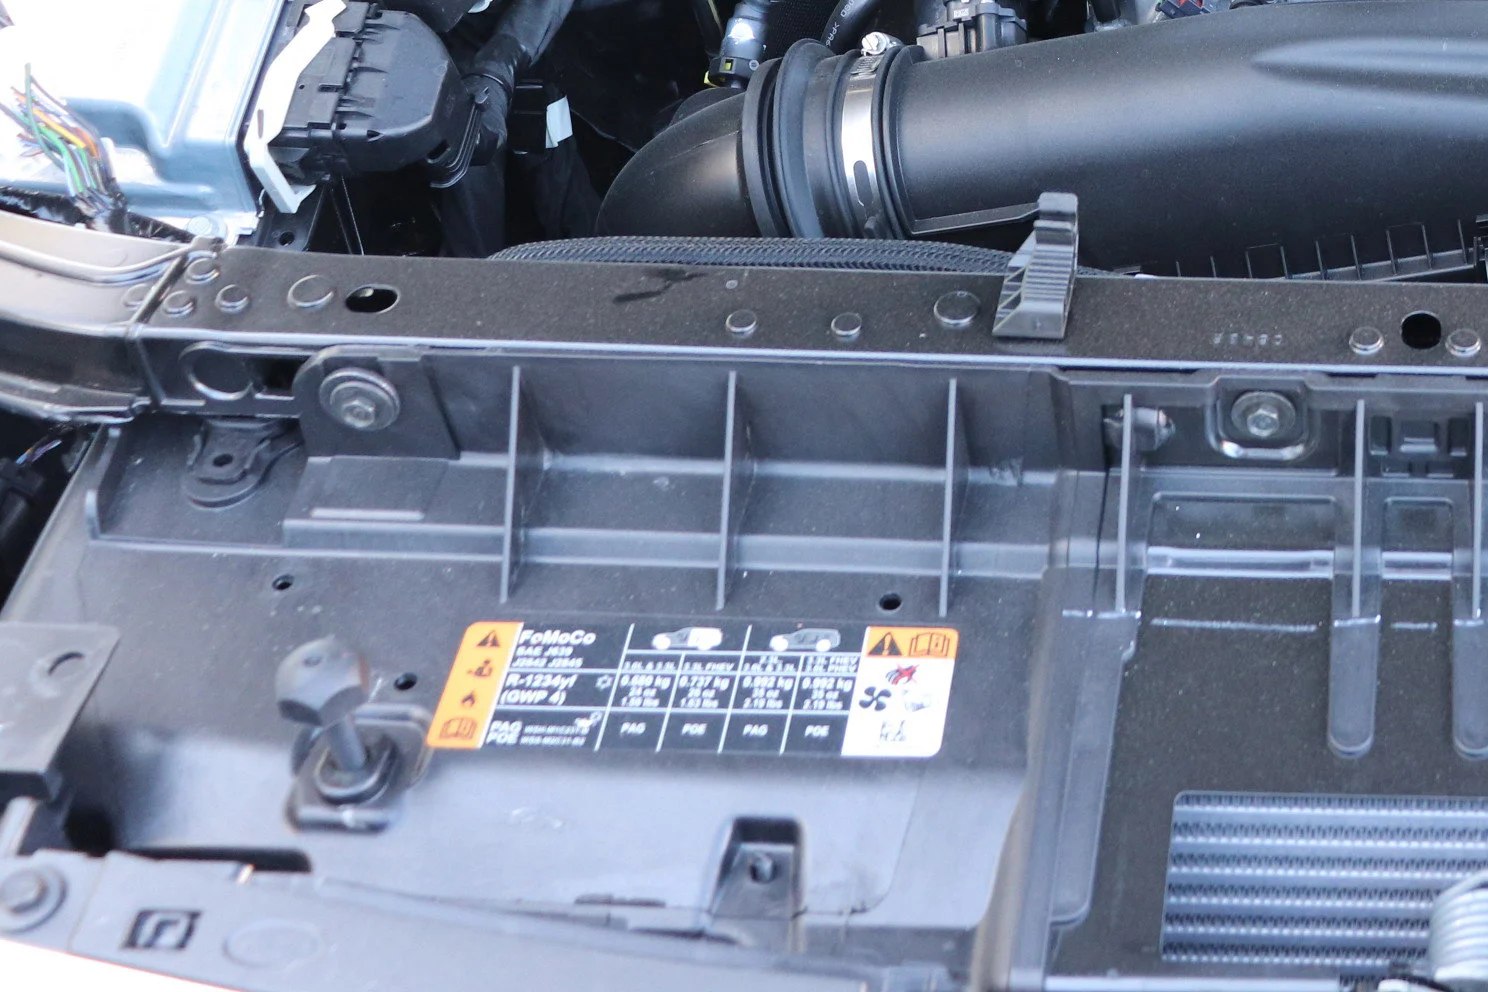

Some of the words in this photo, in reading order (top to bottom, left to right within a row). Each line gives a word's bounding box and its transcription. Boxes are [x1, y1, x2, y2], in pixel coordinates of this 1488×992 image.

[518, 629, 597, 646] FoMoCo
[505, 673, 579, 690] R-1234yf
[654, 675, 672, 690] kg
[713, 675, 731, 691] kg
[776, 676, 794, 692] kg
[836, 677, 853, 693] kg
[500, 689, 549, 705] (GWP
[548, 689, 567, 705] 4)
[489, 719, 523, 734] PAG
[620, 722, 646, 735] PAG
[681, 723, 708, 736] POE
[742, 724, 769, 737] PAG
[804, 725, 830, 738] POE
[485, 732, 519, 745] POE
